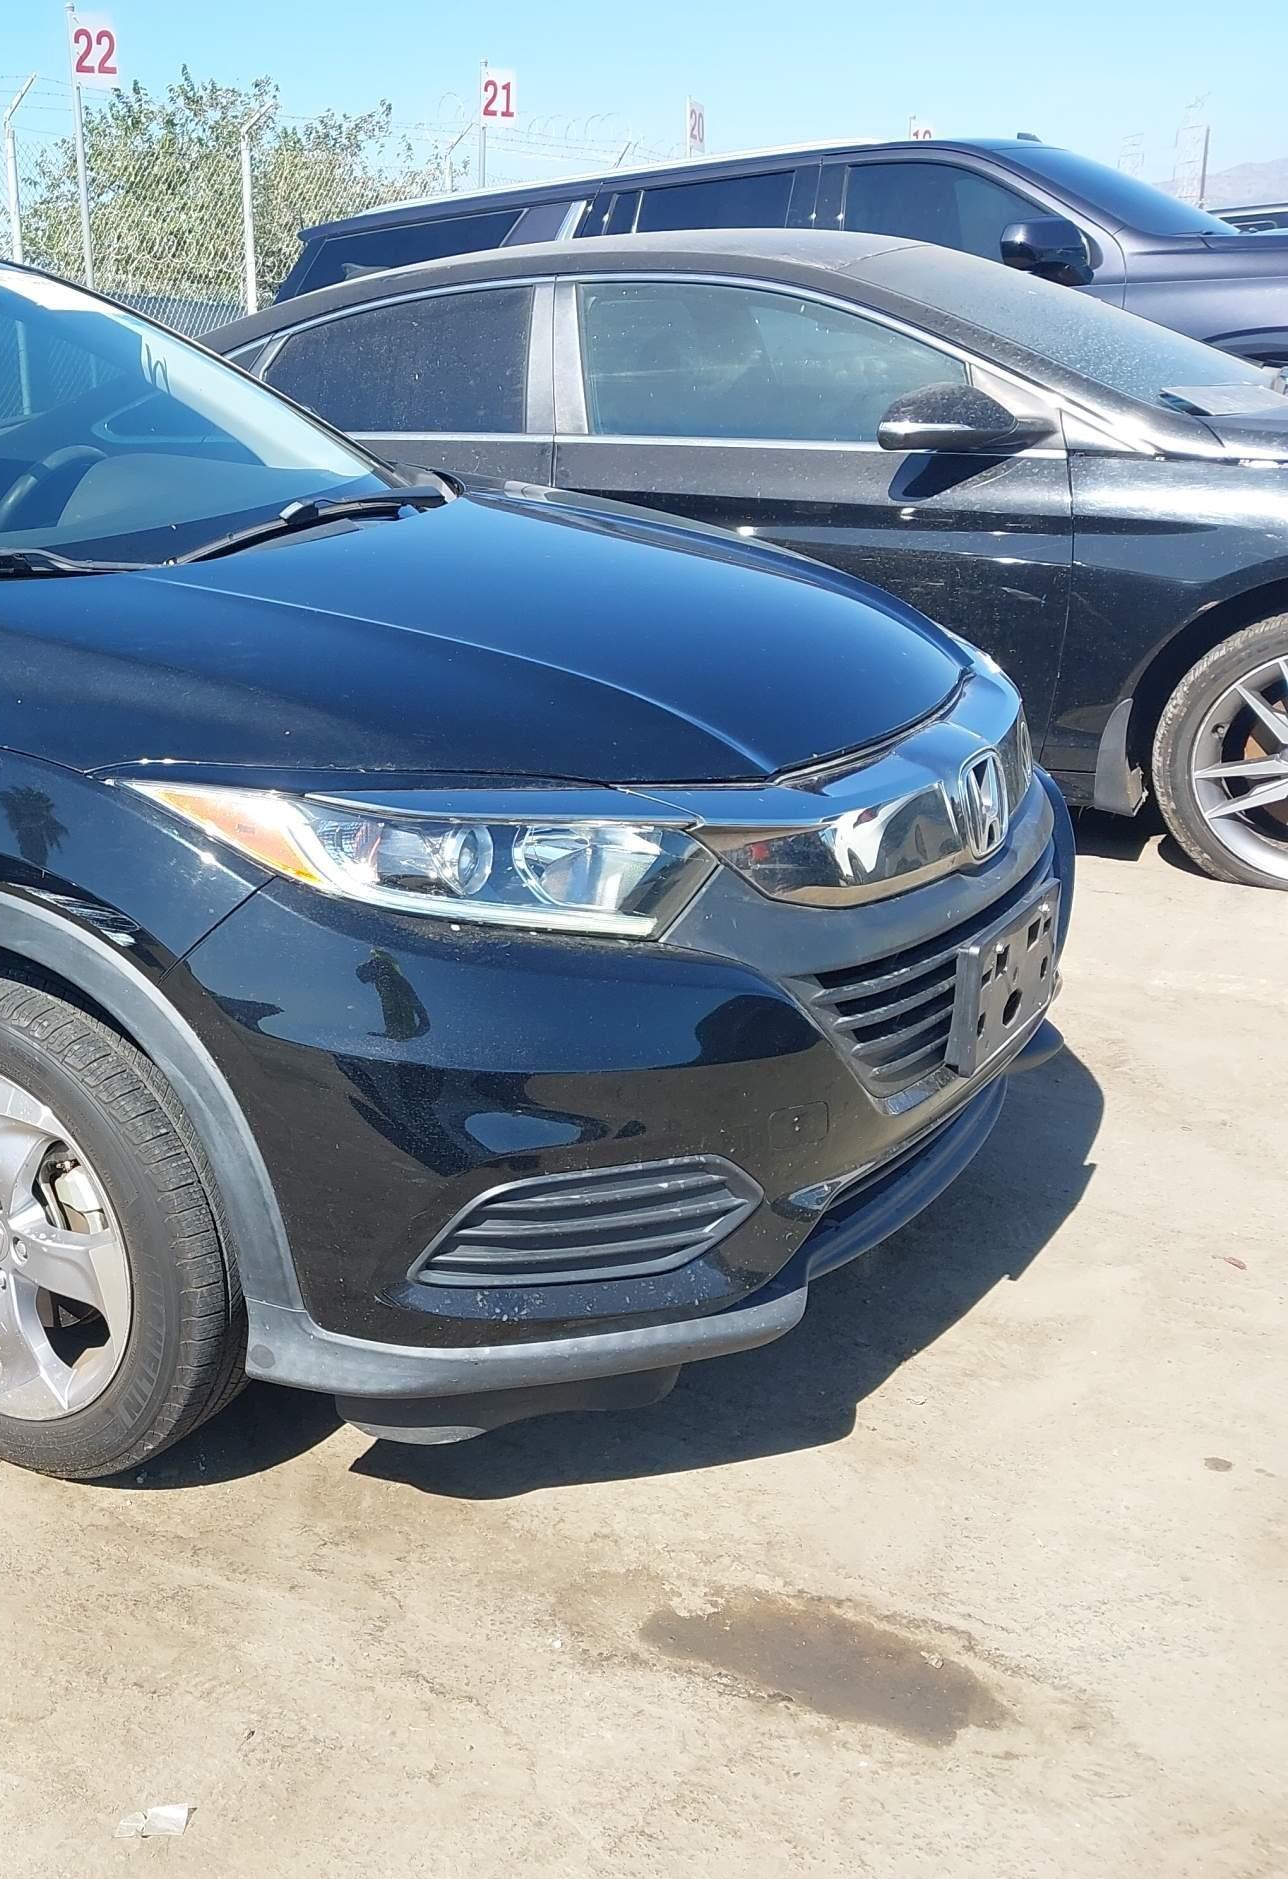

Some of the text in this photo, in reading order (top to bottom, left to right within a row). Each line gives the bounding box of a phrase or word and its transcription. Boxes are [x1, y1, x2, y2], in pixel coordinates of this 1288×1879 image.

[74, 28, 117, 74] 22
[482, 80, 515, 118] 21
[689, 109, 705, 143] 20
